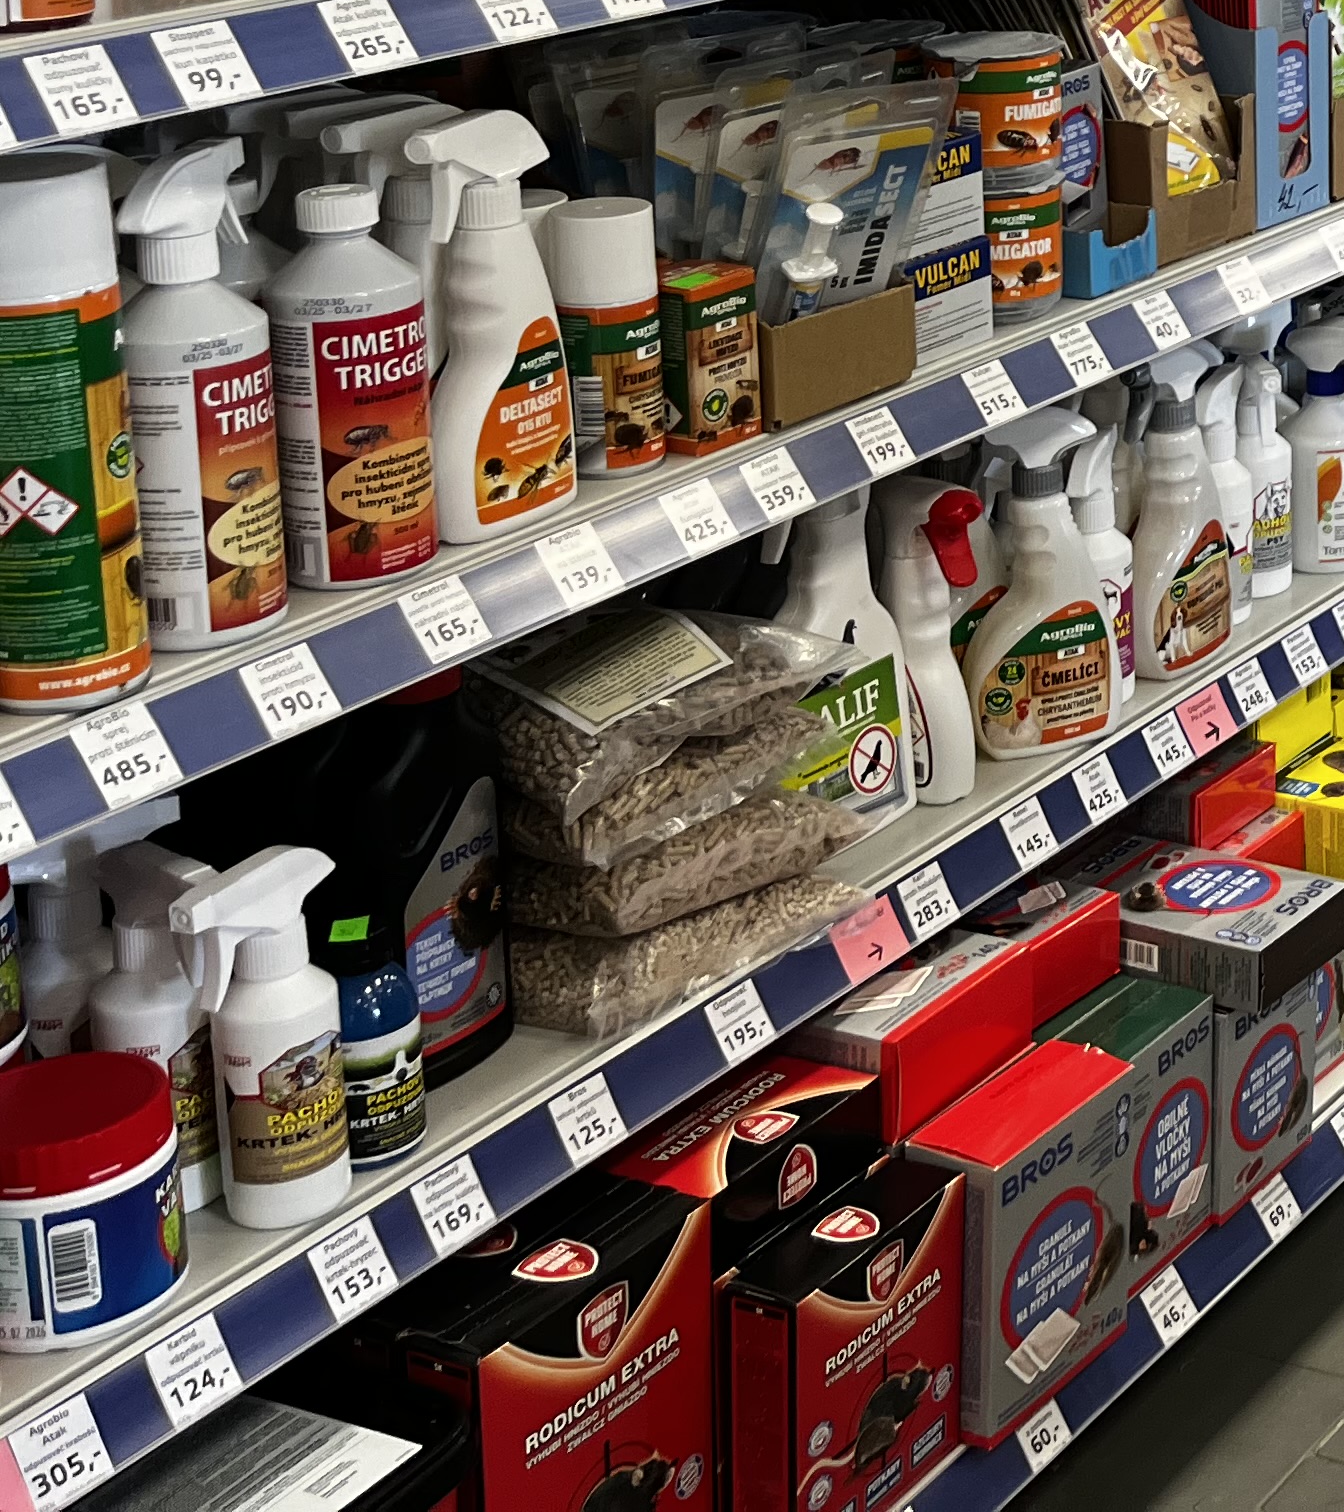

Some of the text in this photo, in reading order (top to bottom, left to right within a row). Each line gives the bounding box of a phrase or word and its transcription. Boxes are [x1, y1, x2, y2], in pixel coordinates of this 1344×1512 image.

[916, 248, 980, 286] VULCAN
[993, 237, 1051, 260] MIGATOR
[334, 347, 425, 389] TRIGGE
[499, 386, 563, 424] DELTASECT
[1040, 661, 1100, 689] ČMELÍCI
[819, 678, 880, 730] ALIF
[440, 828, 493, 872] BROS
[1158, 1020, 1209, 1075] BROS
[1000, 1133, 1075, 1206] BROS
[825, 1269, 941, 1374] RODICUM EXTRA
[526, 1329, 679, 1453] RODICUM EXTRA
